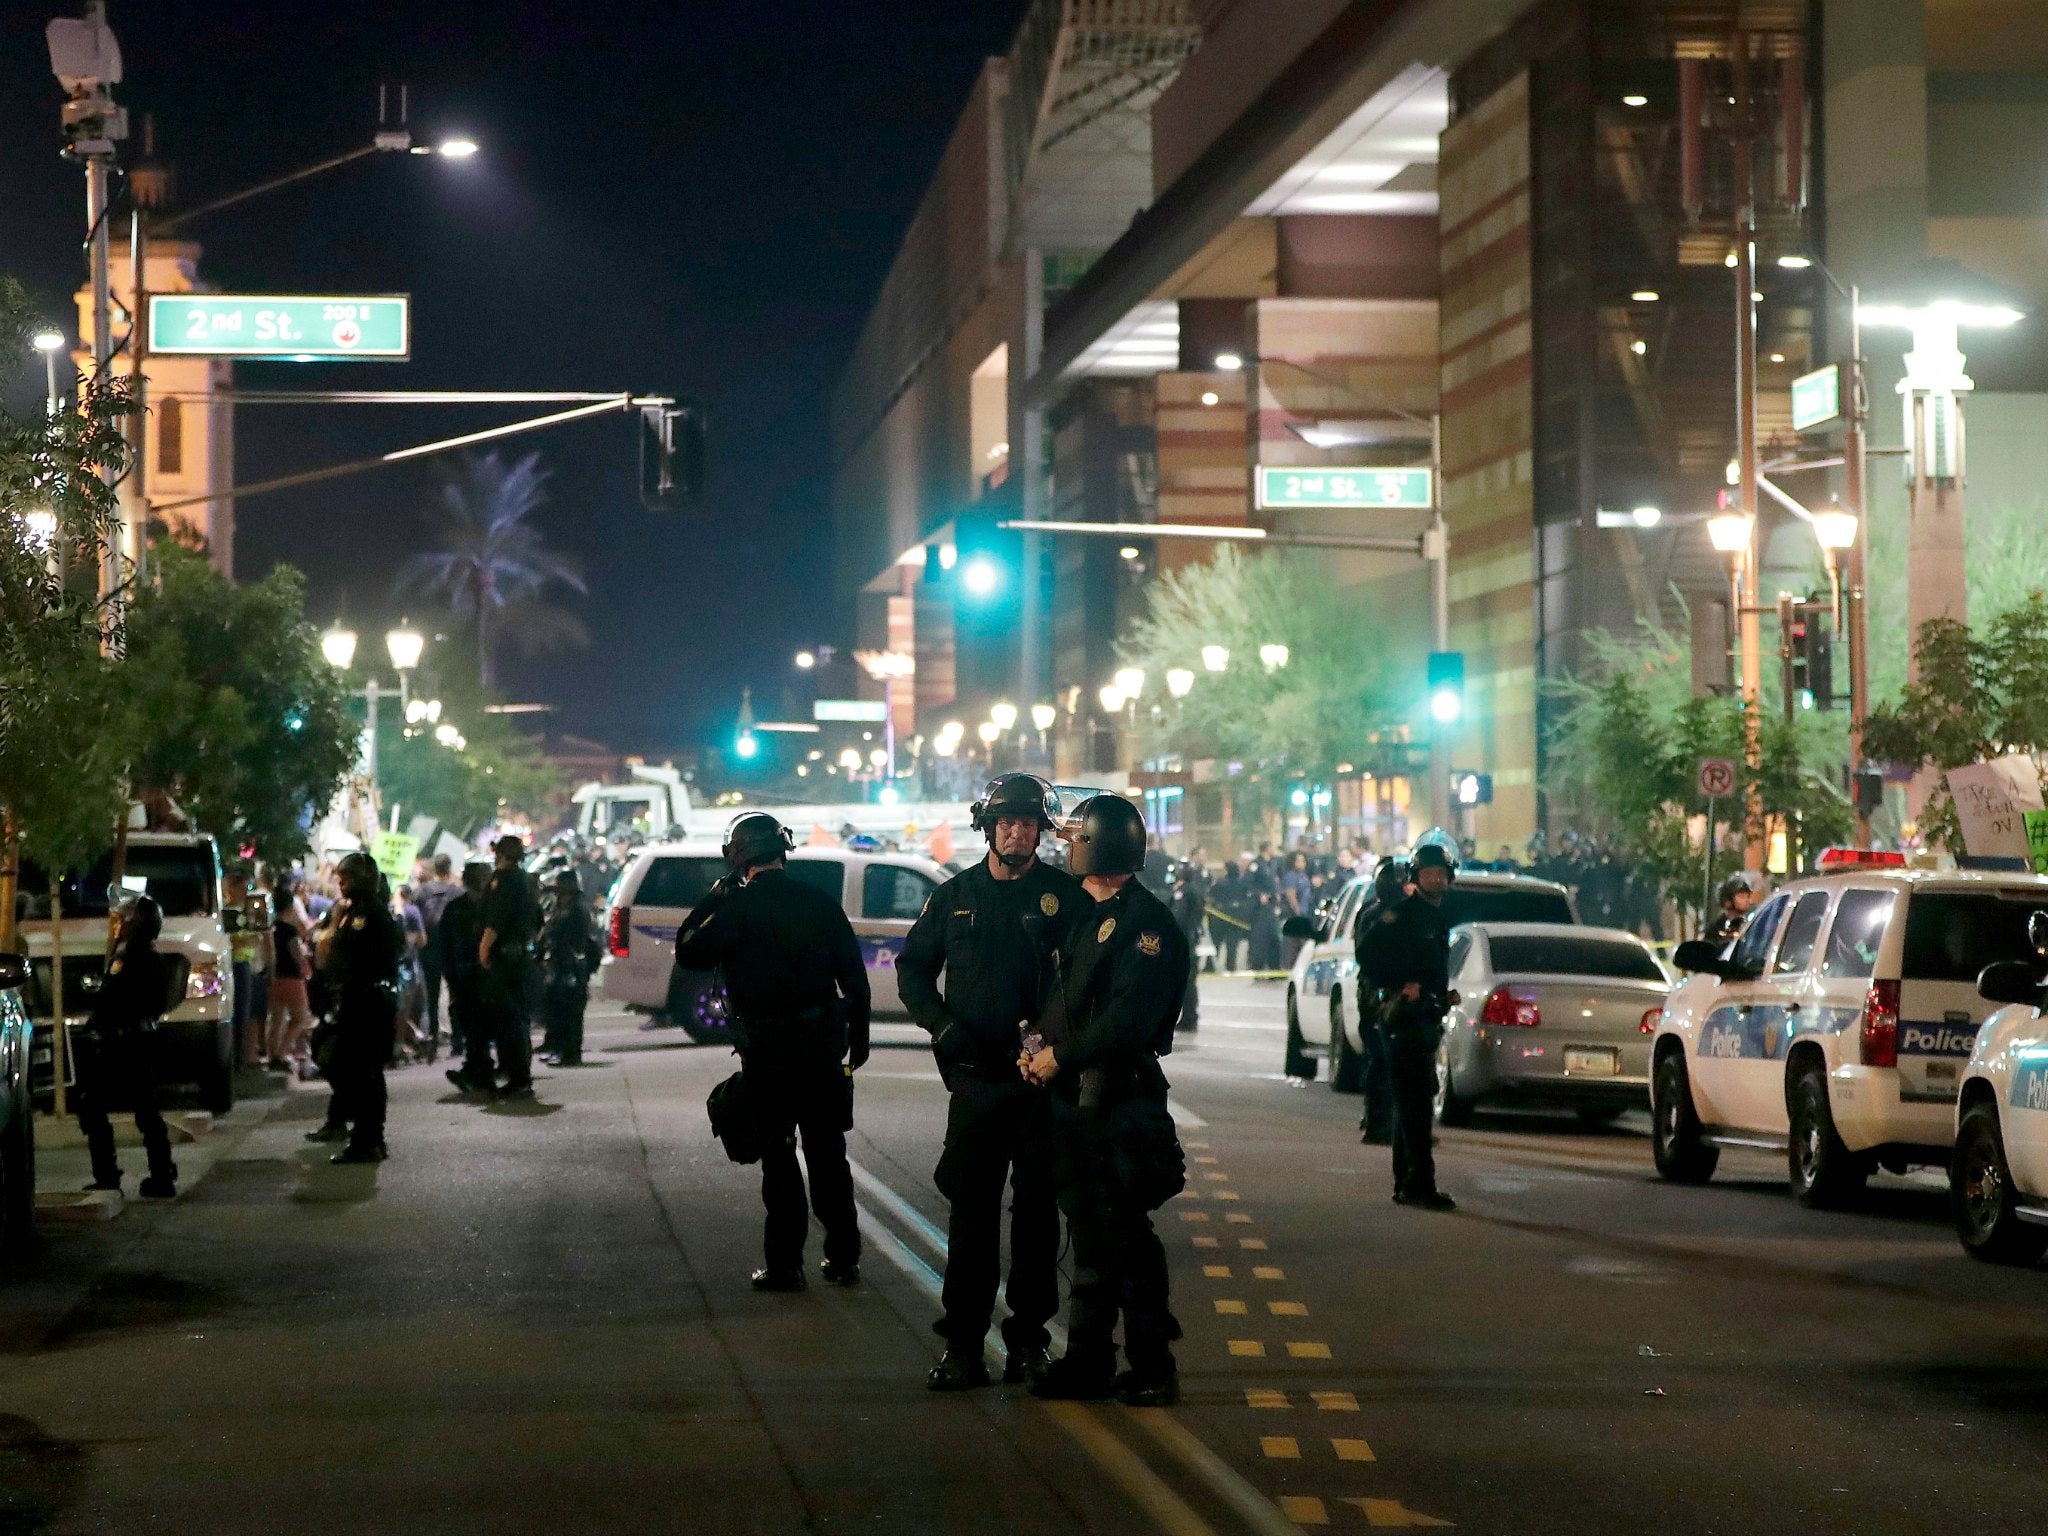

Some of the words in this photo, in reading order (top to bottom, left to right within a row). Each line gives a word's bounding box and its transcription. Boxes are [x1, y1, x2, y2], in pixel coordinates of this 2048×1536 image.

[322, 304, 357, 321] 200
[186, 309, 242, 340] 2nd
[255, 310, 302, 340] St.
[1285, 476, 1324, 498] 2nd
[1330, 476, 1364, 499] St.
[1903, 1028, 1976, 1051] Police
